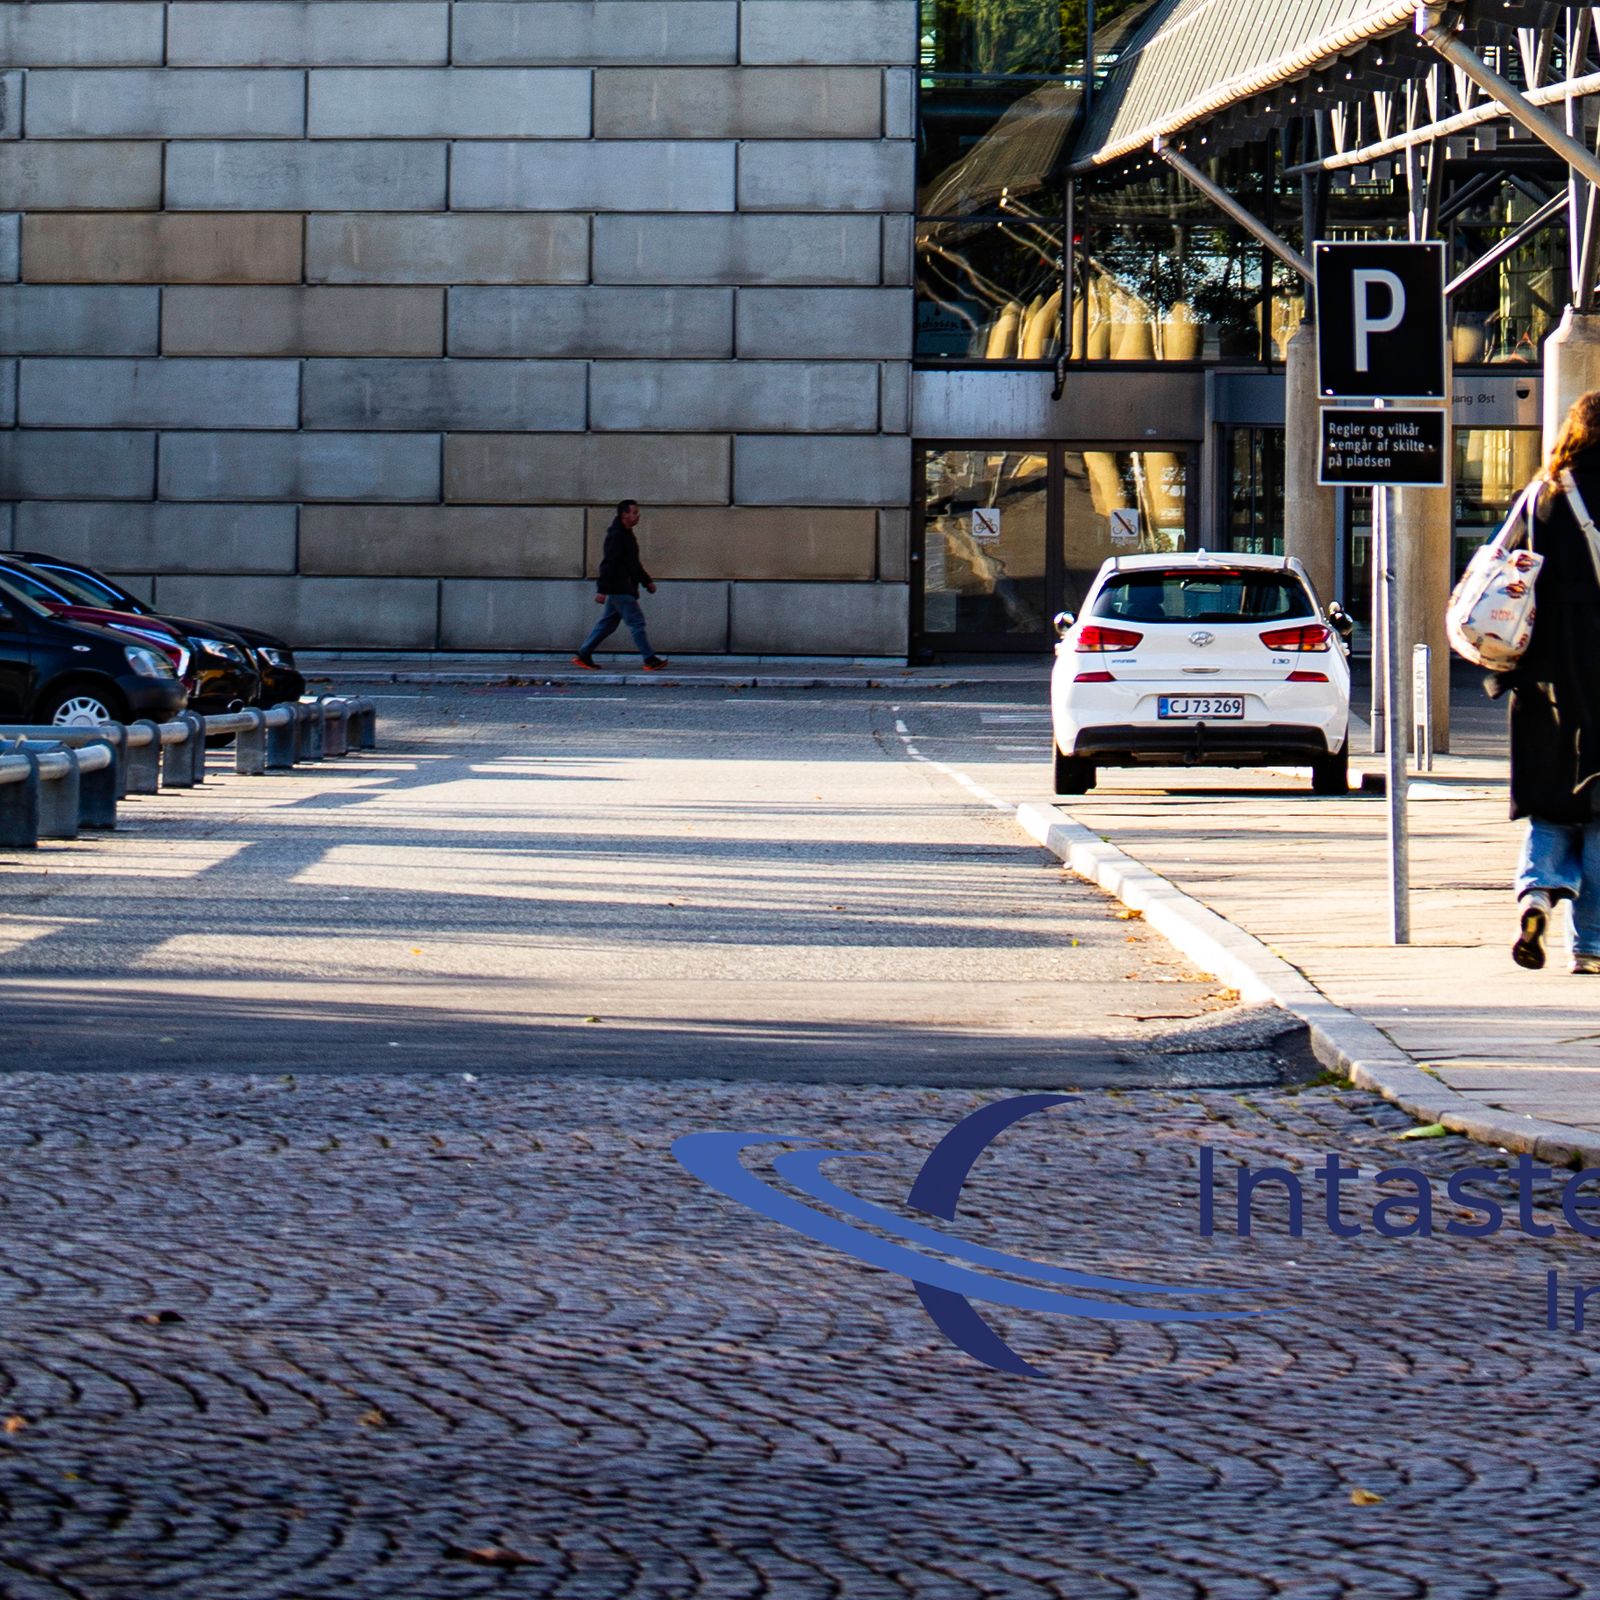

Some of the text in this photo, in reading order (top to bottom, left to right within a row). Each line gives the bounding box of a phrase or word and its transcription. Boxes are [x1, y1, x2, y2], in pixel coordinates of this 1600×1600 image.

[1352, 268, 1406, 373] P
[1477, 393, 1495, 404] Øst
[1328, 422, 1420, 438] Regler og vilkår
[1377, 438, 1389, 451] af
[1393, 438, 1425, 452] skilte
[1328, 453, 1392, 469] på pladsen
[1170, 699, 1241, 714] CJ 73 269
